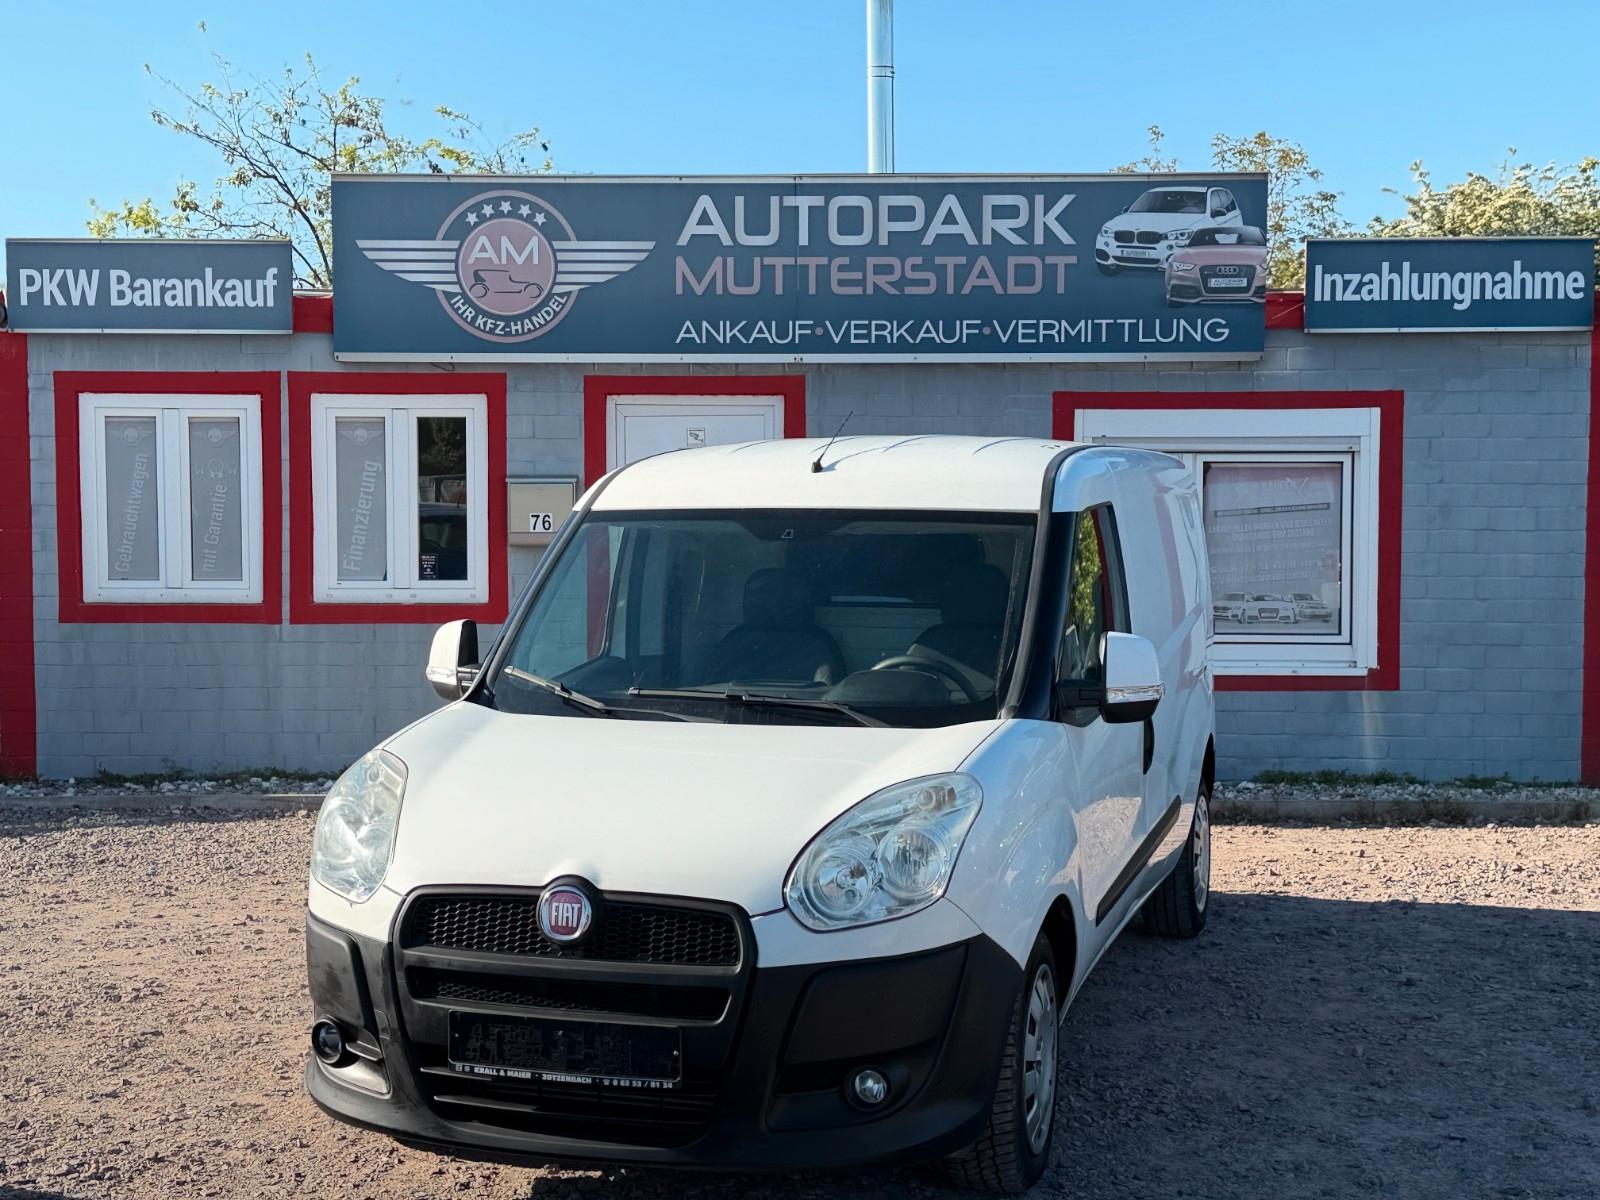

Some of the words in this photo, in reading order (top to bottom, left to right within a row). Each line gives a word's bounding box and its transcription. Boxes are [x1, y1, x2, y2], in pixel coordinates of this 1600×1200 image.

[676, 193, 1077, 247] AUTOPARK
[467, 234, 539, 265] AM
[19, 268, 99, 306] PKW
[109, 267, 278, 307] Barankauf
[675, 254, 1078, 296] MUTTERSTADT
[1313, 260, 1585, 310] Inzahlungnahme
[450, 295, 476, 322] IHR
[475, 295, 568, 335] KFZ-HANDEL
[675, 320, 813, 344] ANKAUF
[825, 319, 980, 344] VERKAUF
[993, 317, 1230, 343] VERMITTLUNG
[115, 453, 149, 573] Gebrauchtwagen
[204, 484, 228, 545] Garantie
[343, 460, 383, 572] Finanzierung
[530, 513, 552, 531] 76
[201, 549, 217, 573] mit
[551, 902, 581, 928] FIAT
